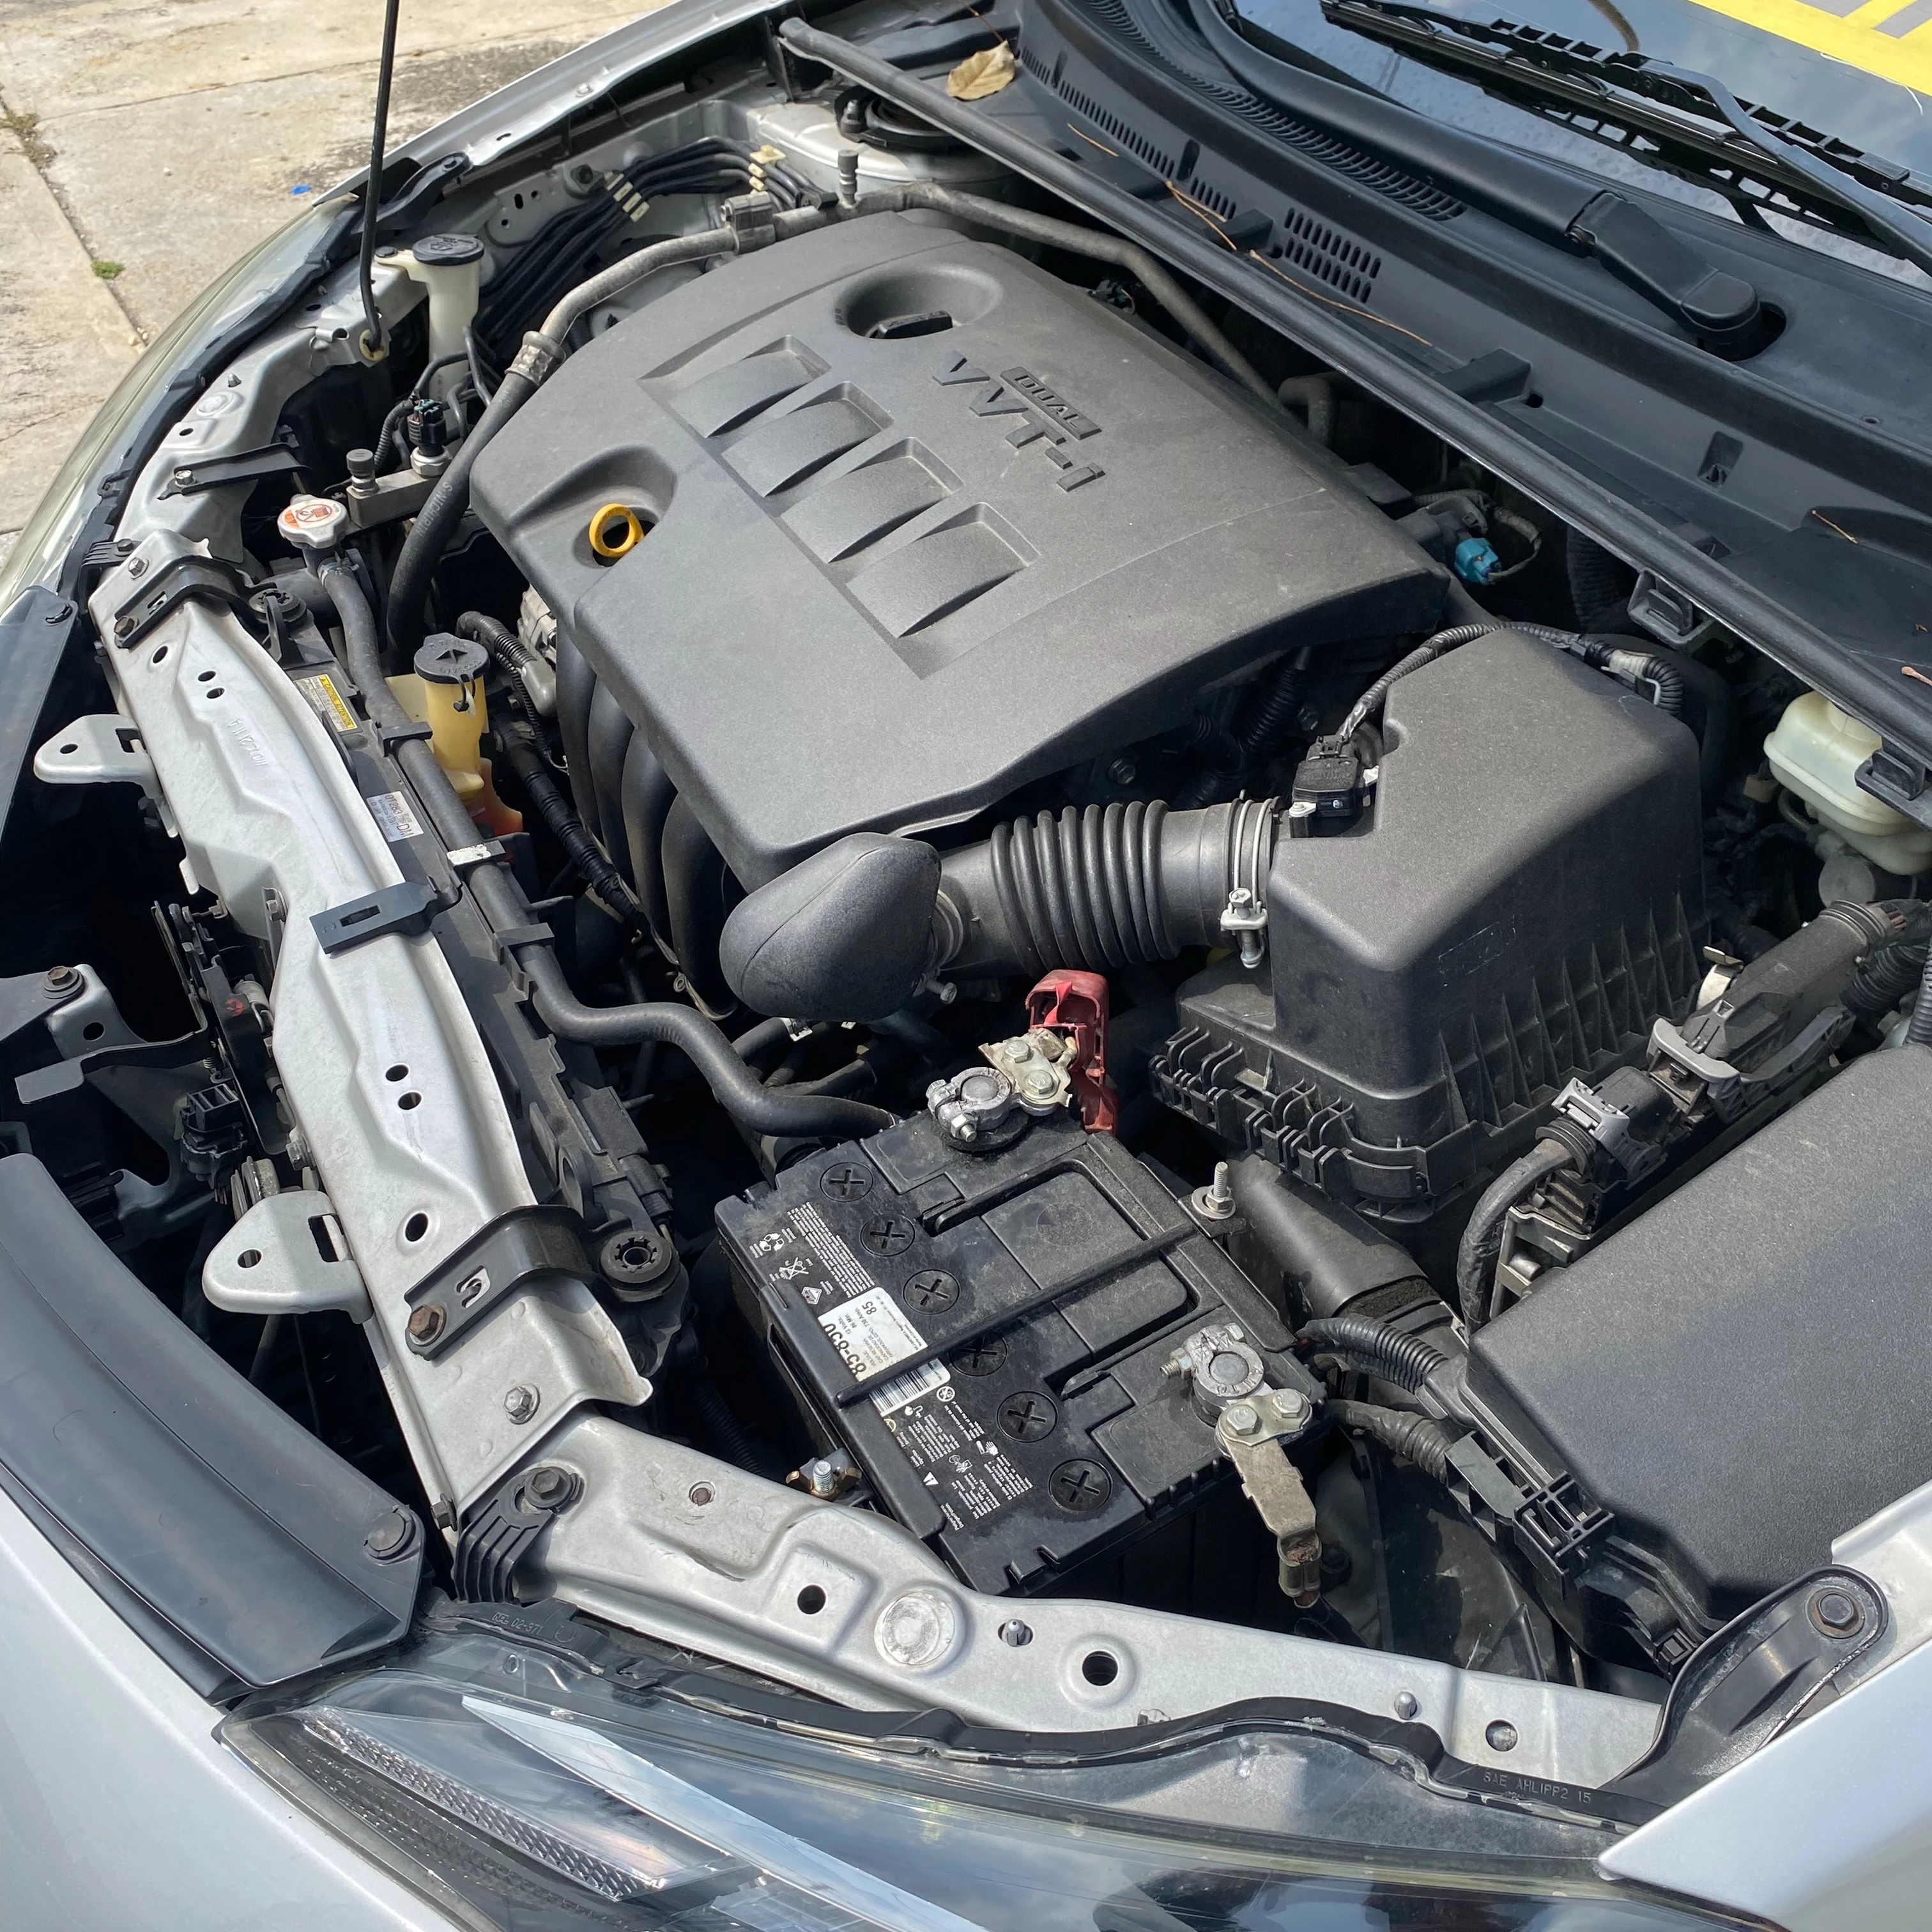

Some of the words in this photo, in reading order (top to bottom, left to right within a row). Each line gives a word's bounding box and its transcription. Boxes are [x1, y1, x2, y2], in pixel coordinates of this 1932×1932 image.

[1015, 374, 1082, 428] DUAL
[861, 1300, 877, 1316] 85
[1483, 1771, 1507, 1788] SAE
[1577, 1792, 1591, 1804] 15
